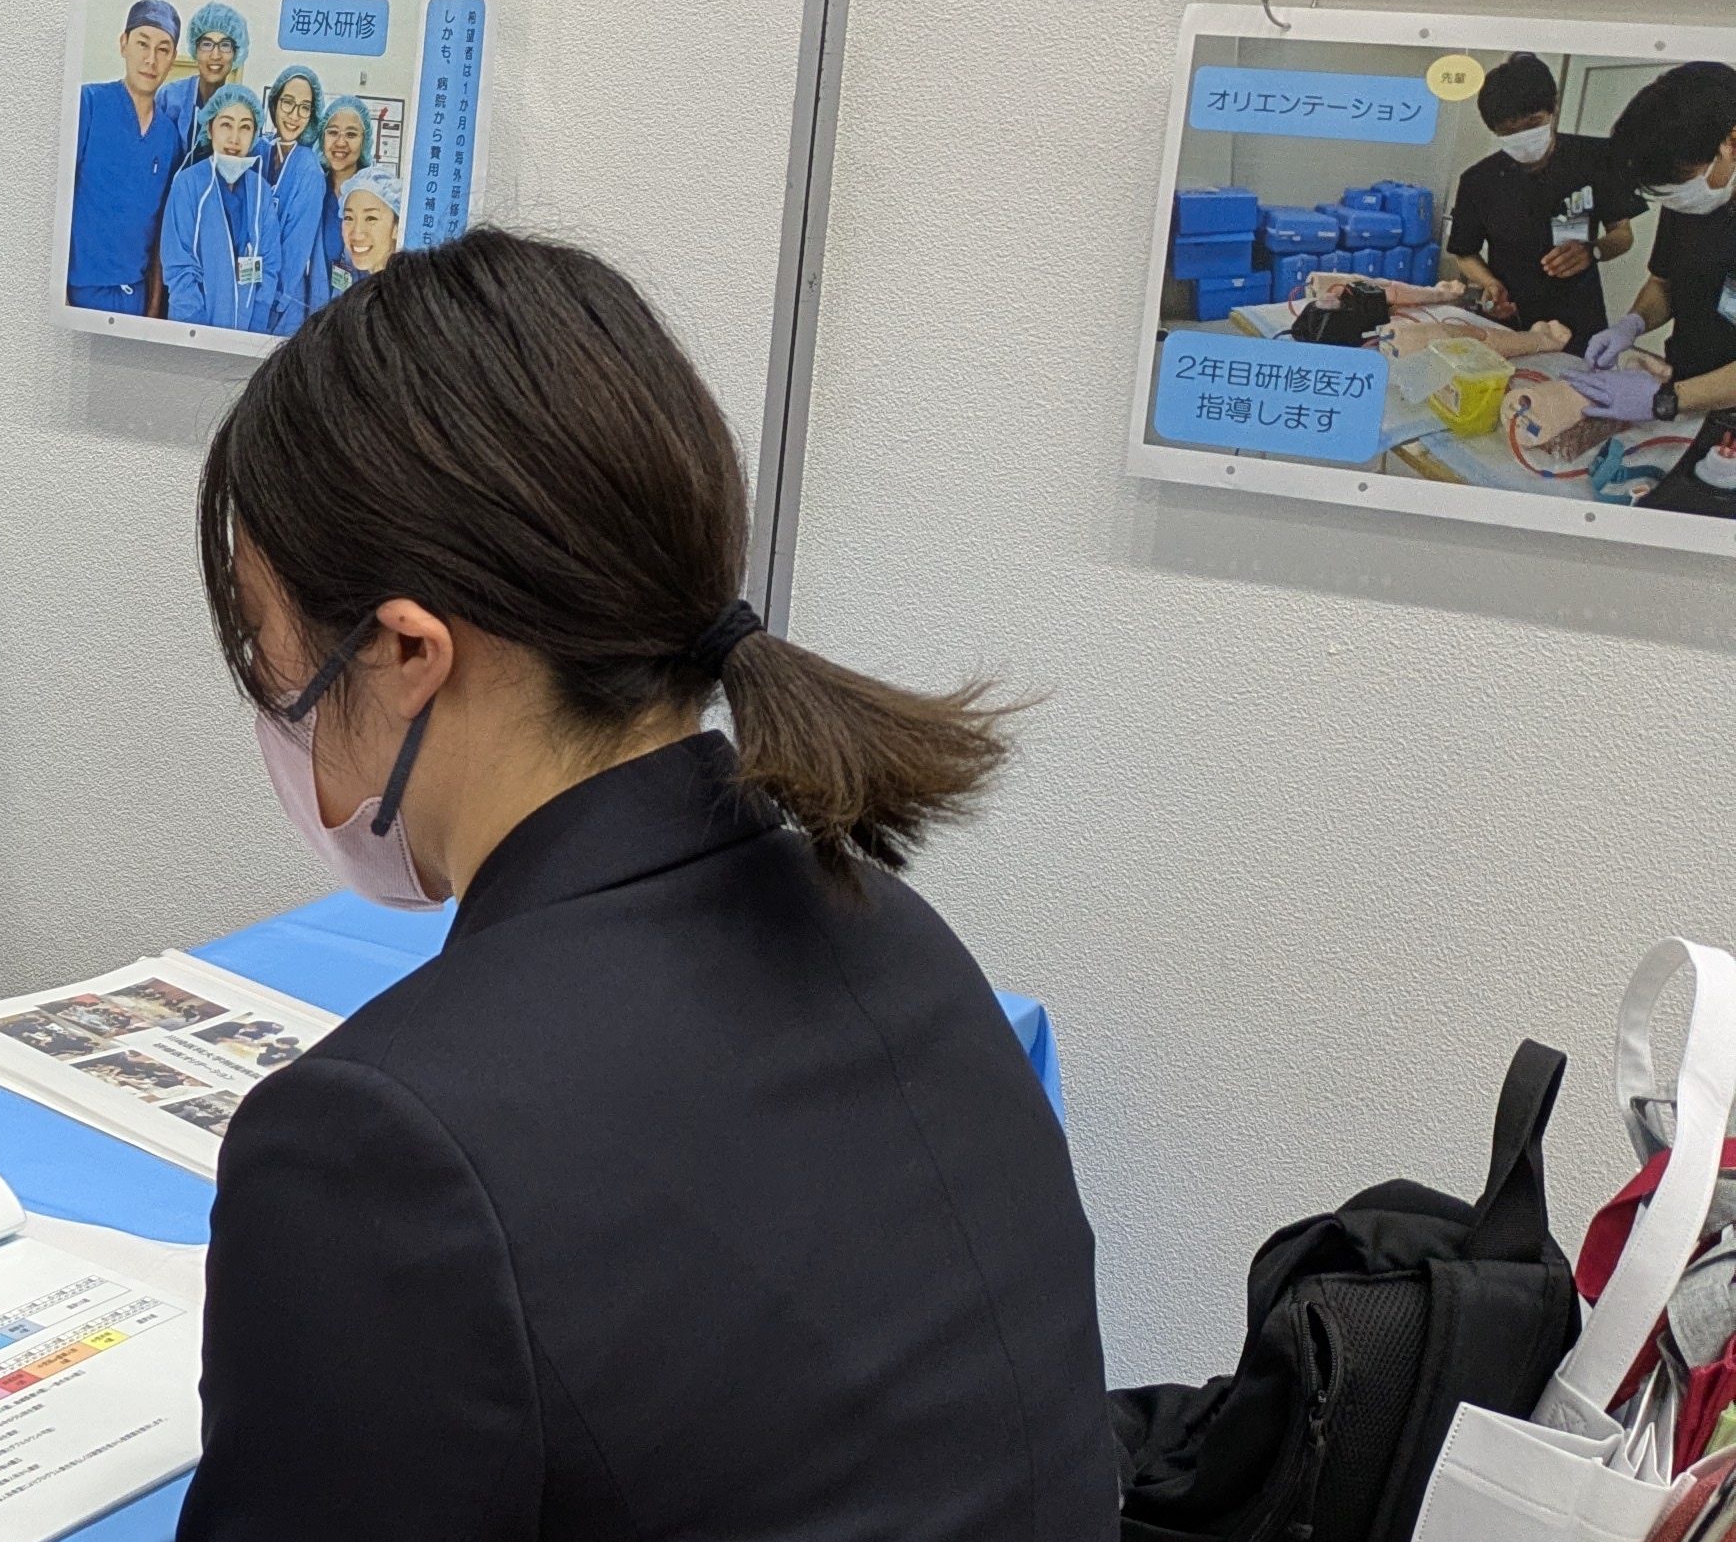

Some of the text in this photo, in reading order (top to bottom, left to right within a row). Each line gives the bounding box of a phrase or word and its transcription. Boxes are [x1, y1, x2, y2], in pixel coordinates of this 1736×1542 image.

[290, 9, 377, 40] 海外研修
[1206, 88, 1423, 124] オリエンテーション
[1175, 354, 1374, 400] 2年目研修医が
[1196, 393, 1342, 434] 指導します
